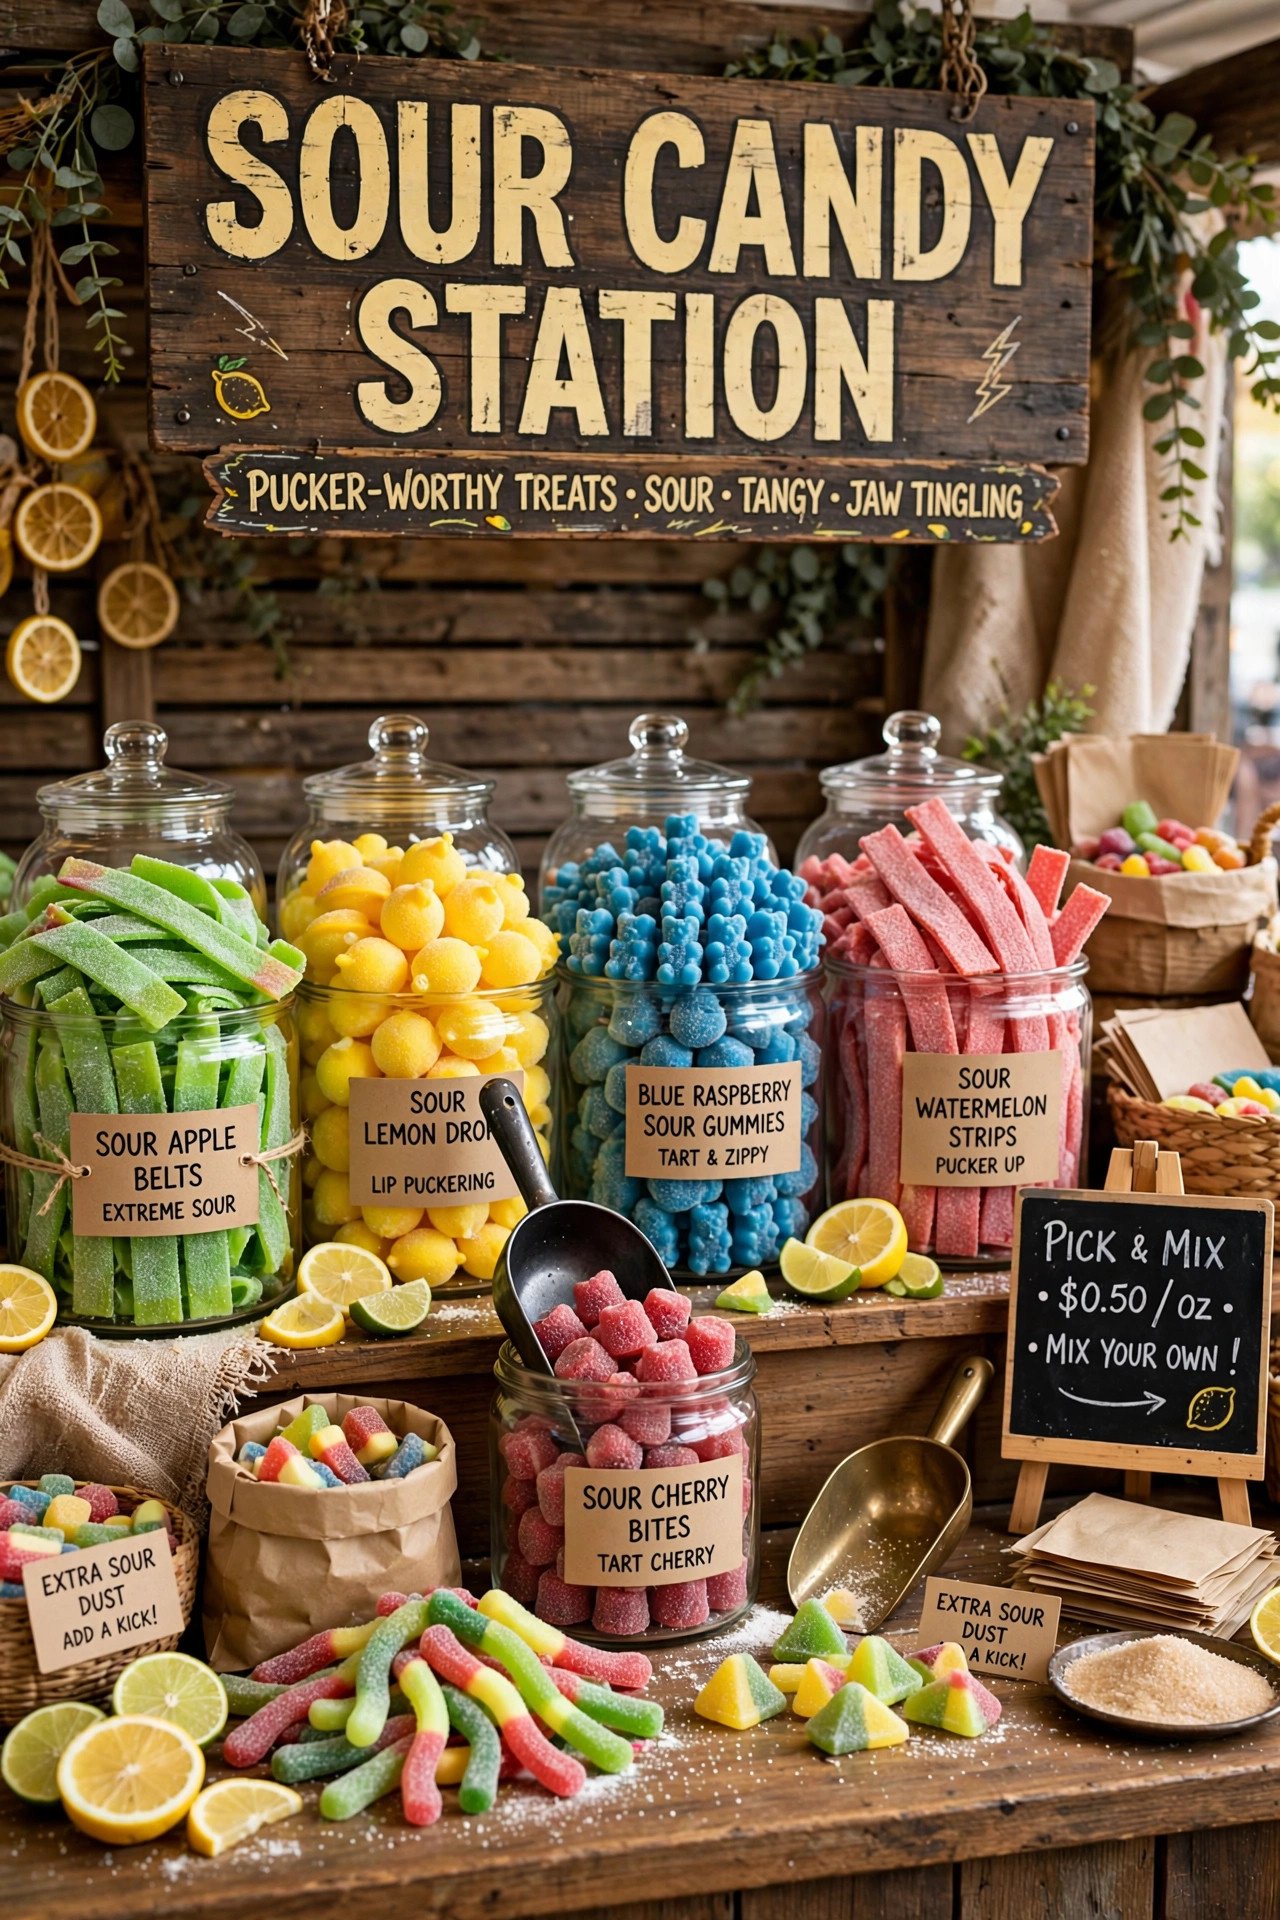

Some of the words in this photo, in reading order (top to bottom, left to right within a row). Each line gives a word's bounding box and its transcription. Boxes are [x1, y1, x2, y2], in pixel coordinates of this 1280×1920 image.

[205, 90, 574, 269] SOUR
[624, 110, 1055, 286] CANDY
[357, 278, 895, 443] STATION
[246, 467, 504, 512] PUCKER-WORTHY
[515, 473, 618, 512] TREATS
[644, 474, 714, 514] SOUR
[738, 476, 825, 515] TANGY
[846, 479, 903, 517] JAW
[911, 480, 1023, 519] TINGLING
[638, 1083, 685, 1106] BLUE
[693, 1079, 792, 1106] RASPBERRY
[958, 1067, 1011, 1089] SOUR
[411, 1090, 466, 1114] SOUR
[915, 1094, 1047, 1119] WATERMELON
[364, 1121, 436, 1145] LEMON
[643, 1113, 695, 1137] SOUR
[703, 1110, 785, 1137] GUMMIES
[949, 1125, 1017, 1148] STRIPS
[96, 1130, 158, 1157] SOUR
[168, 1125, 236, 1155] APPLE
[658, 1148, 700, 1166] TART
[707, 1149, 718, 1166] &
[725, 1145, 769, 1165] ZIPPY
[134, 1162, 202, 1191] BELTS
[936, 1156, 998, 1174] PUCKER
[1004, 1155, 1025, 1173] UP
[372, 1175, 397, 1194] LIP
[404, 1172, 495, 1194] PUCKERING
[103, 1201, 185, 1222] EXTREME
[192, 1194, 236, 1218] SOUR
[1043, 1219, 1117, 1264] PICK
[1130, 1233, 1148, 1264] &
[1162, 1228, 1226, 1270] MIX
[1045, 1332, 1091, 1365] MIX
[1100, 1338, 1157, 1369] YOUR
[583, 1484, 642, 1510] SOUR
[651, 1474, 729, 1509] CHERRY
[629, 1514, 691, 1543] BITES
[41, 1562, 103, 1597] EXTRA
[108, 1547, 157, 1578] SOUR
[597, 1553, 643, 1573] TART
[650, 1544, 715, 1572] CHERRY
[78, 1584, 125, 1616] DUST
[936, 1592, 992, 1617] EXTRA
[998, 1602, 1045, 1628] SOUR
[63, 1625, 94, 1650] ADD
[101, 1621, 112, 1639] A
[116, 1604, 158, 1635] KICK!
[962, 1621, 1008, 1644] DUST
[969, 1647, 980, 1662] A
[985, 1649, 1027, 1671] KICK!
